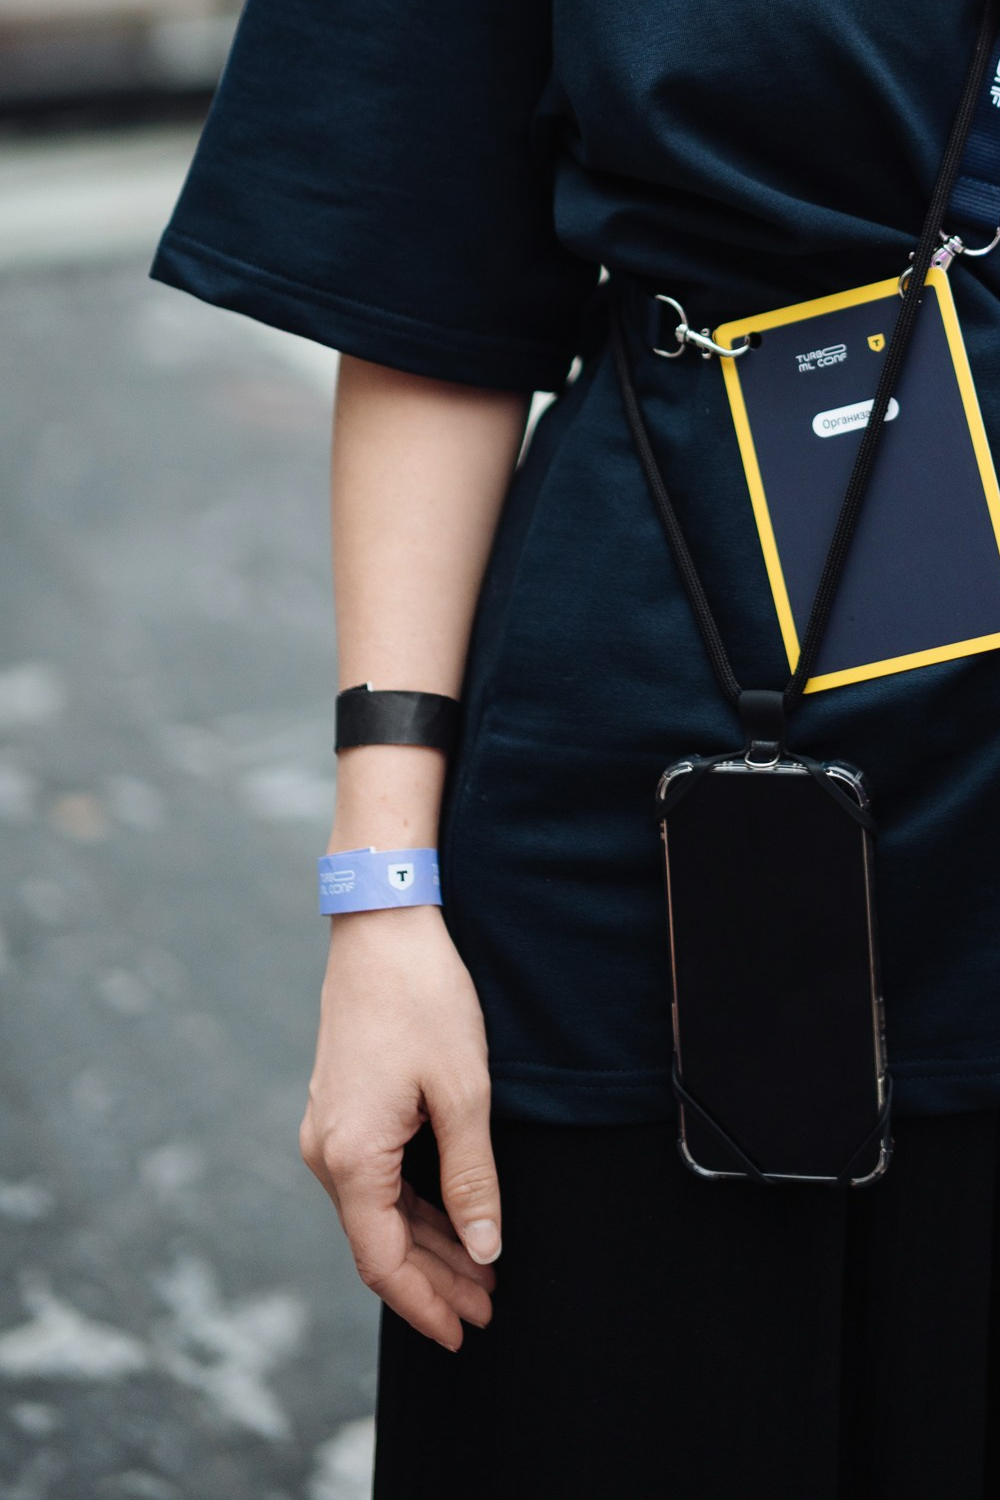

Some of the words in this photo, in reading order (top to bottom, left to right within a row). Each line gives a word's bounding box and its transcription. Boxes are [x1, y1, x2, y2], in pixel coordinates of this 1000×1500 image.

[796, 343, 847, 363] TURBO
[798, 361, 816, 373] ML
[817, 352, 847, 368] CONF
[822, 409, 873, 430] Организа
